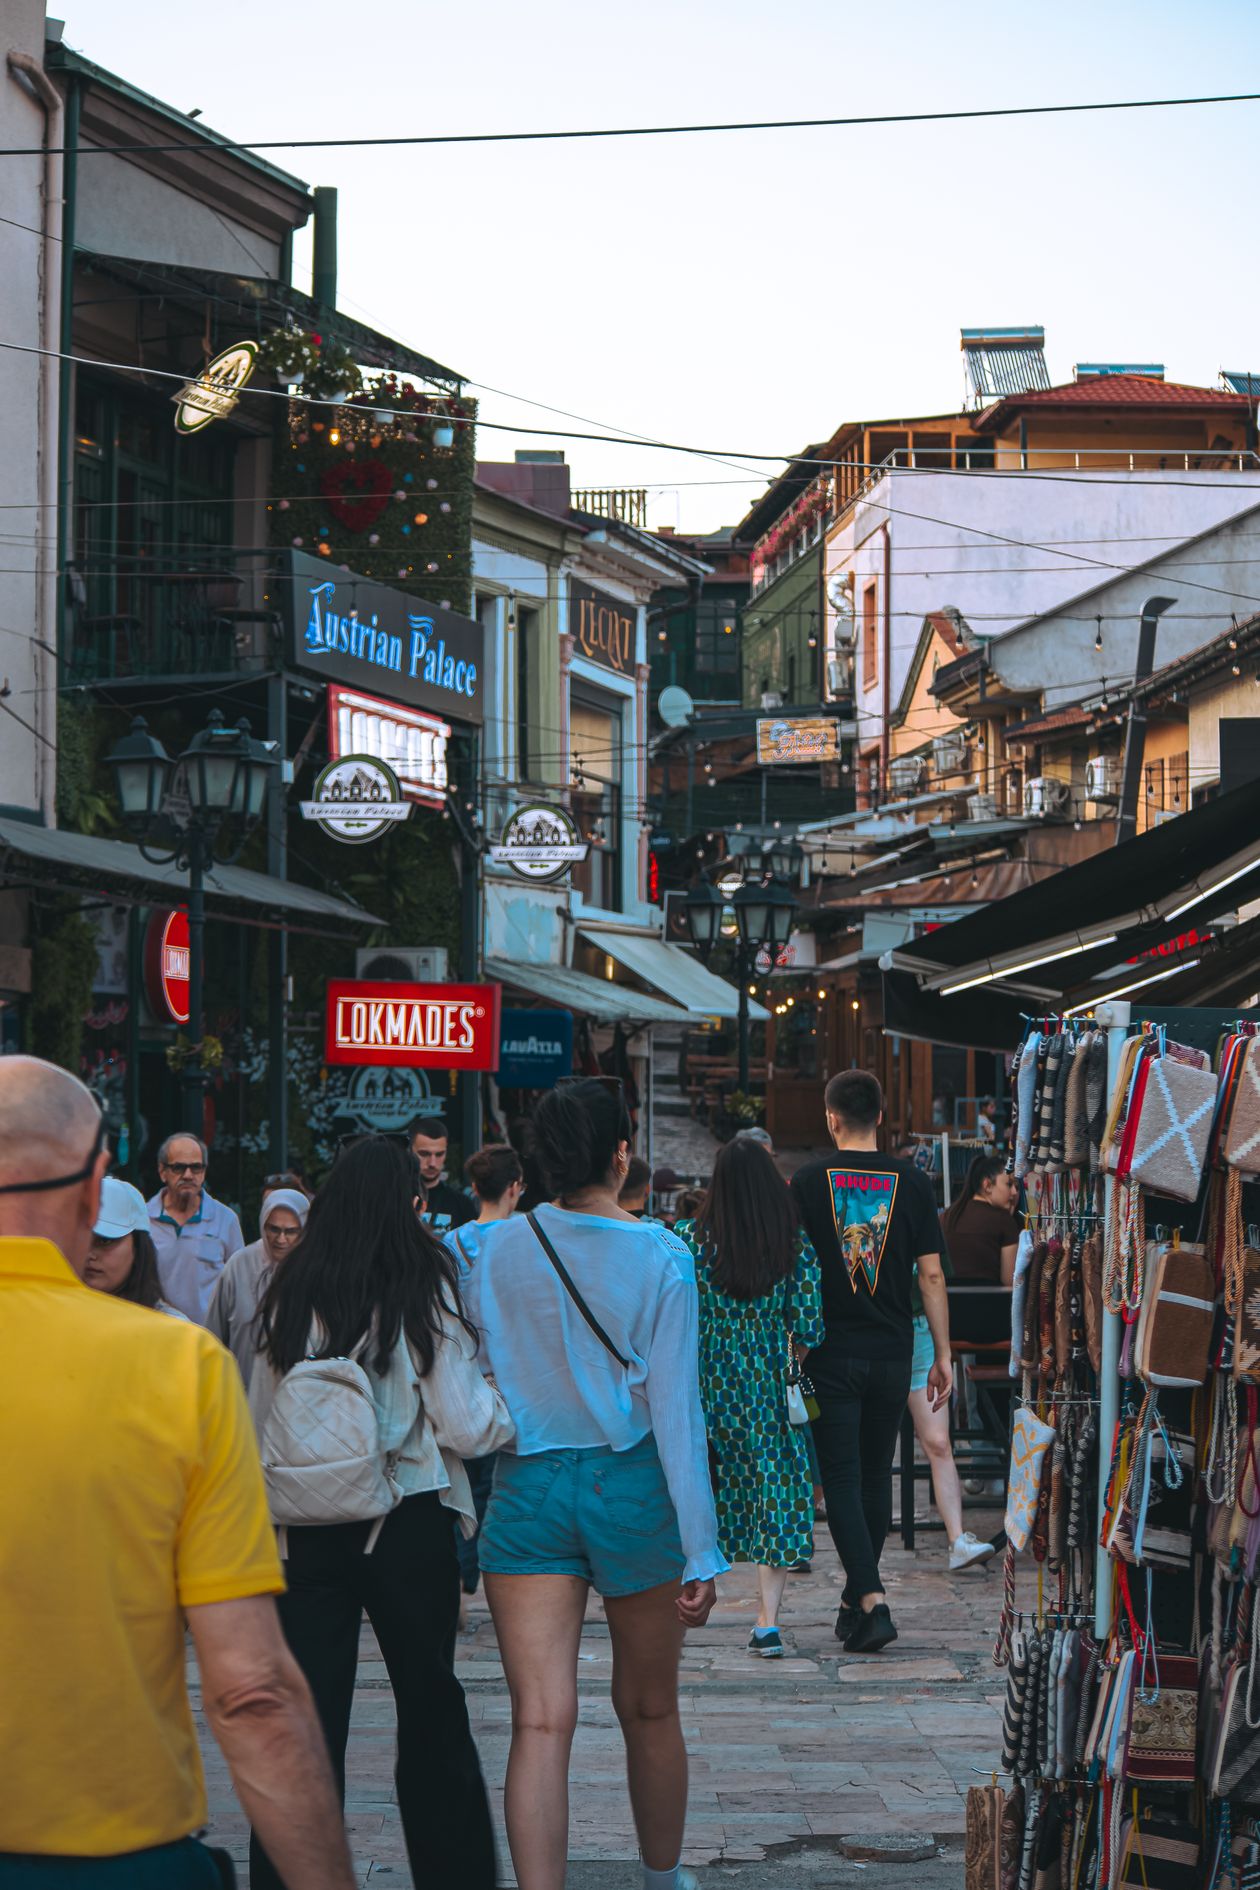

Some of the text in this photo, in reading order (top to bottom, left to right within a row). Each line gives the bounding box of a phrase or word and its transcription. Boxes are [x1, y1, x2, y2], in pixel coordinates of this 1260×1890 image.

[304, 581, 477, 697] Austrian Palace
[835, 1174, 892, 1191] RHUDE
